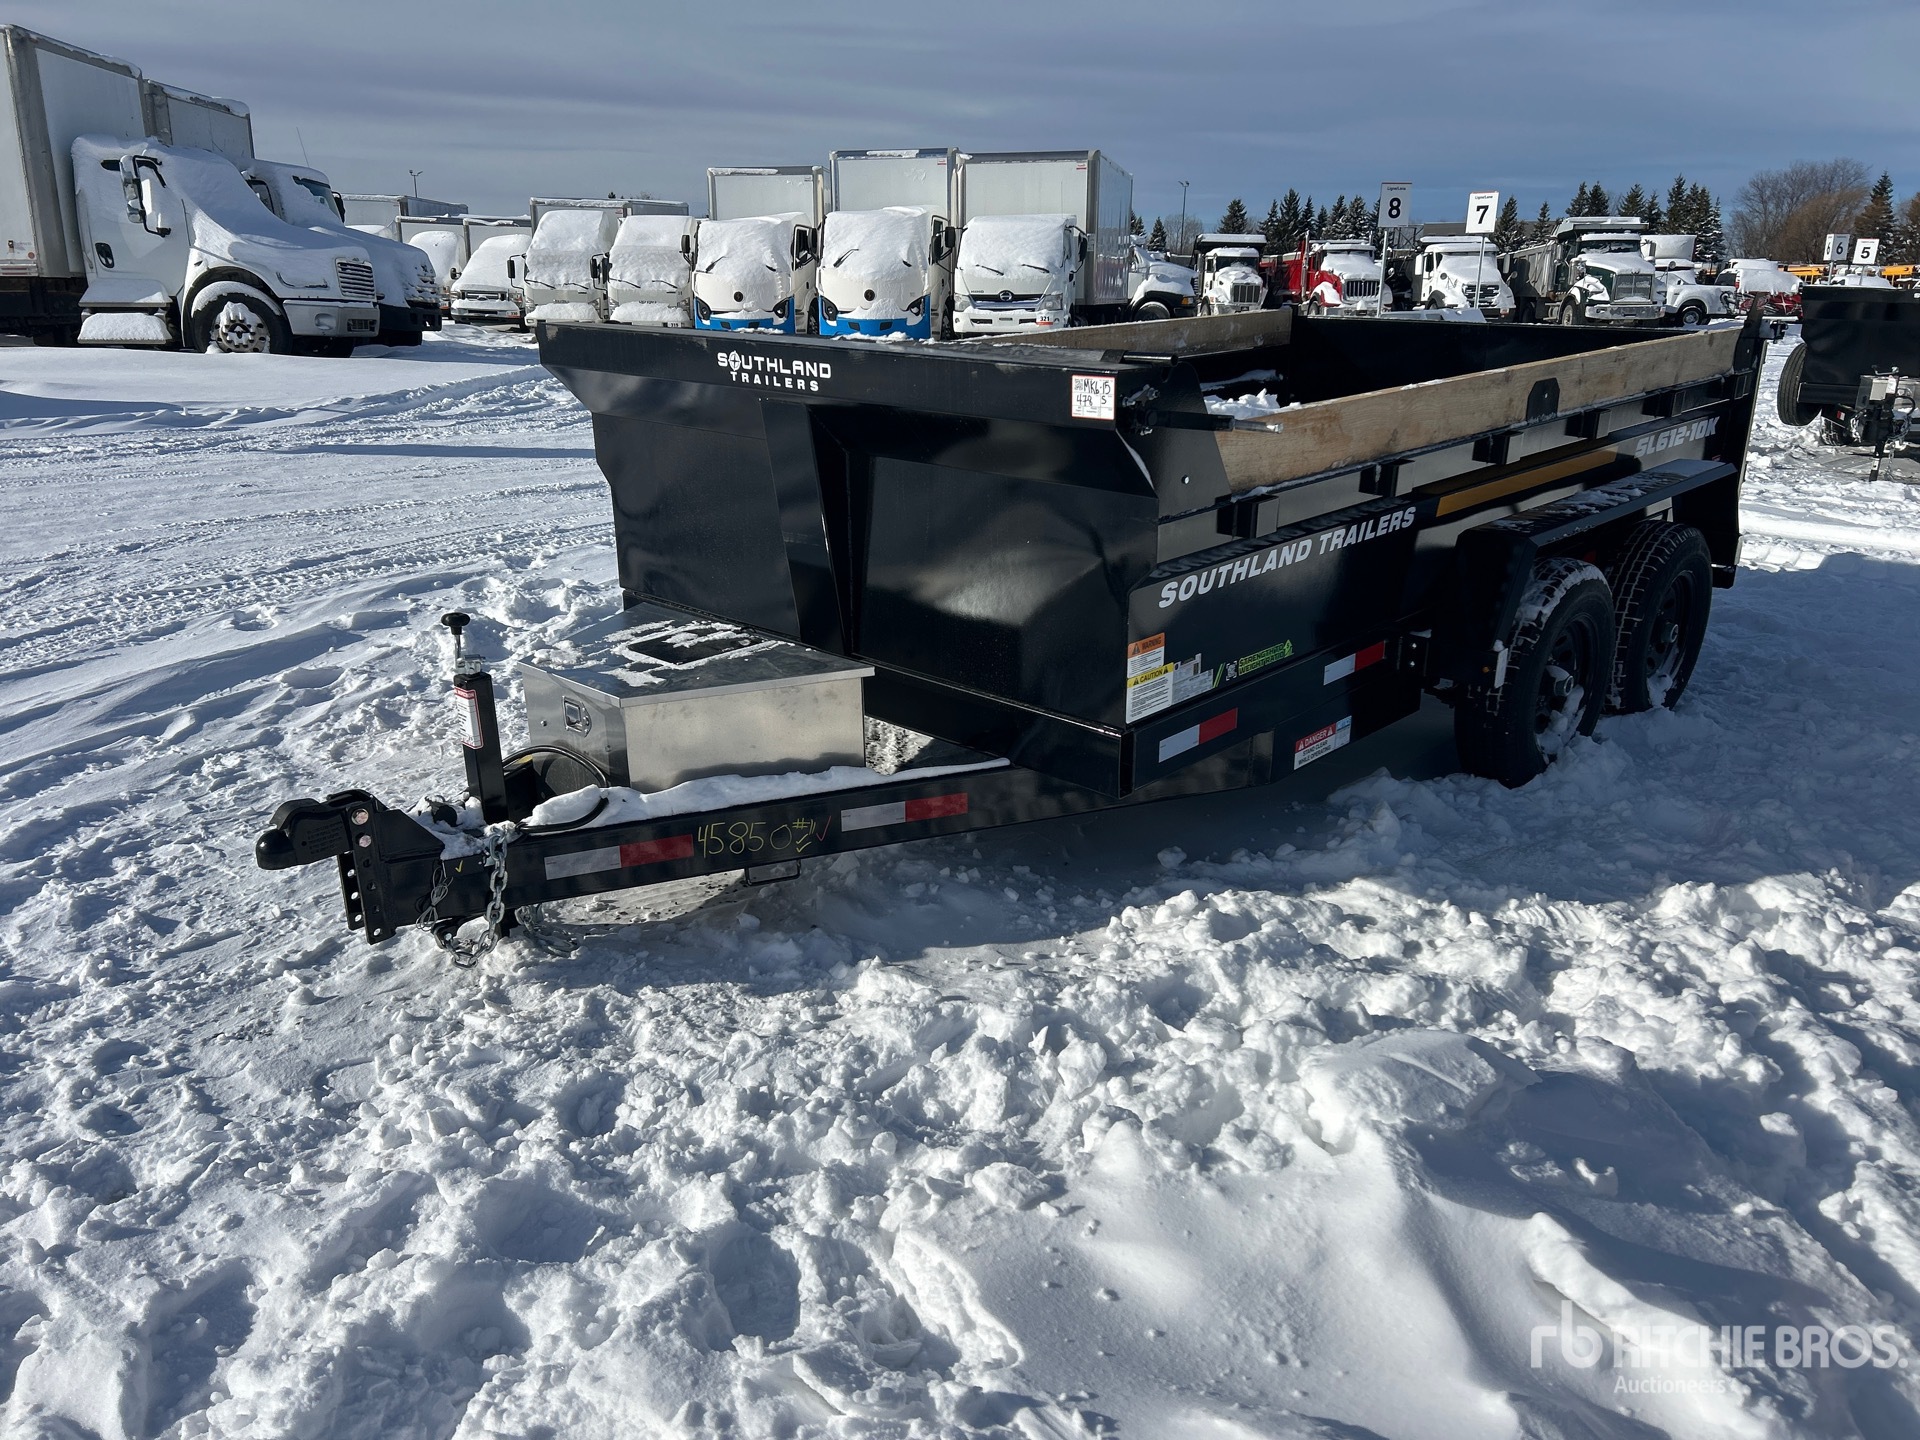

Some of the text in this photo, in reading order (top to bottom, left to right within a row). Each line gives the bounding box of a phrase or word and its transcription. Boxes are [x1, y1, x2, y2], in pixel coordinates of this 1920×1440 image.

[1388, 197, 1402, 219] 8
[1476, 205, 1490, 225] 7
[1836, 241, 1844, 255] 6
[1860, 246, 1872, 259] 5
[717, 350, 832, 379] SOUTHLAND
[730, 371, 819, 392] TRAILERS
[1633, 416, 1720, 459] SL612-10K
[1158, 506, 1417, 609] SOUTHLAND TRAILERS
[1141, 636, 1162, 650] WARNING
[1139, 668, 1163, 683] CAUTION
[1304, 730, 1328, 747] DANGER
